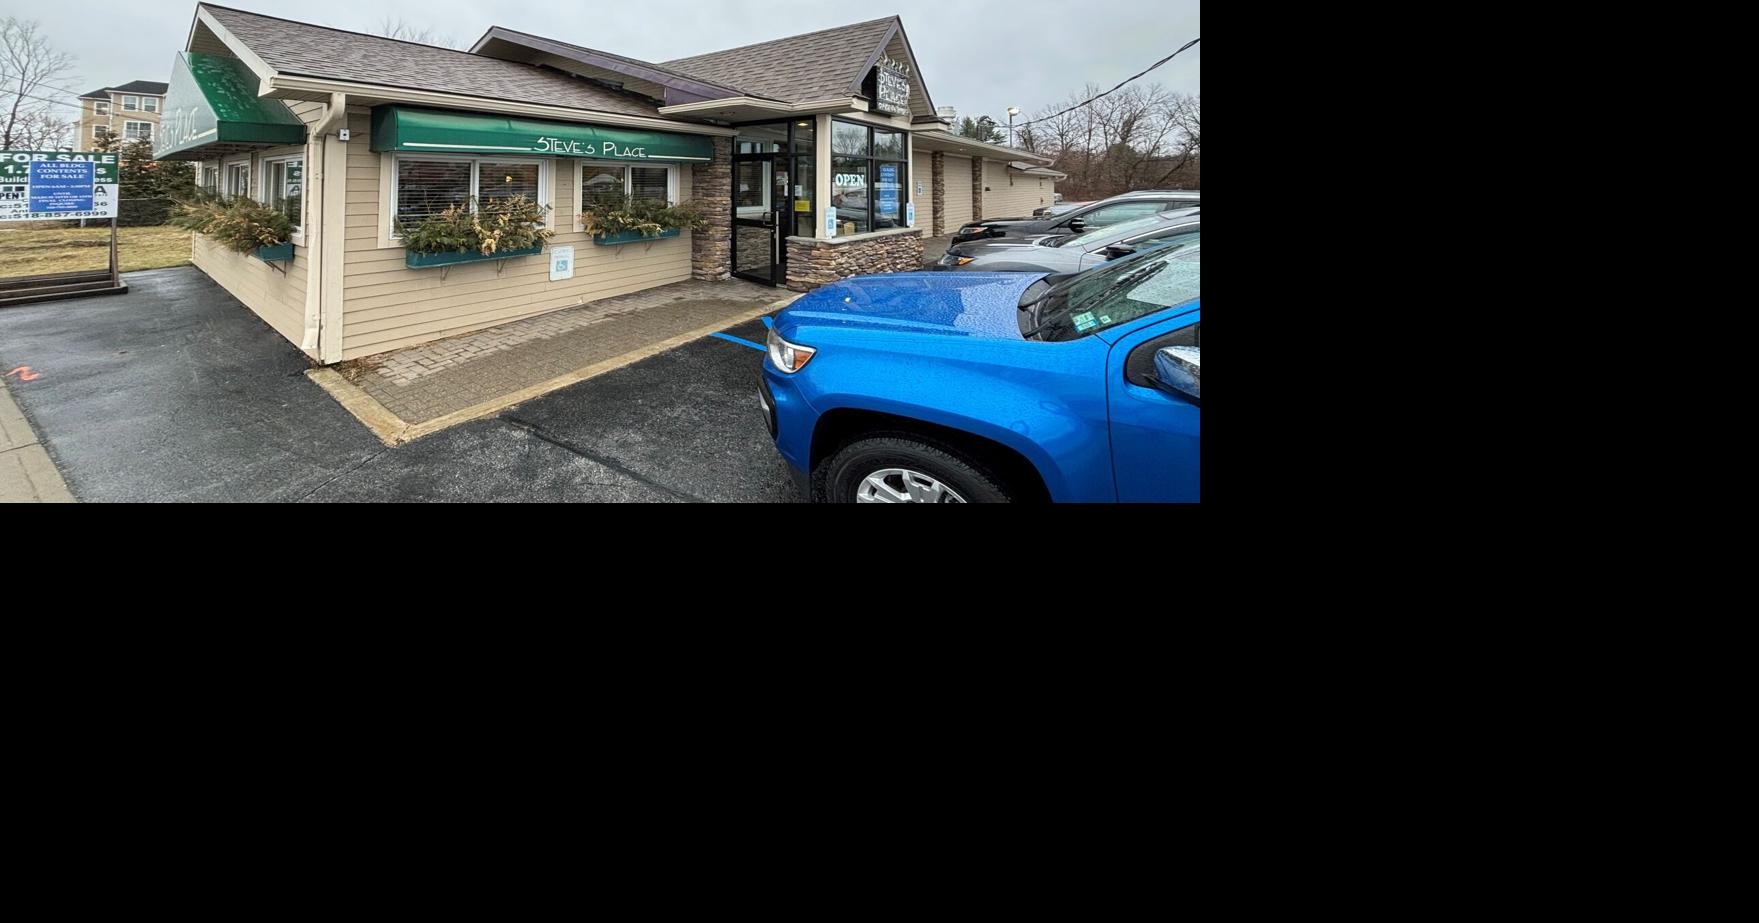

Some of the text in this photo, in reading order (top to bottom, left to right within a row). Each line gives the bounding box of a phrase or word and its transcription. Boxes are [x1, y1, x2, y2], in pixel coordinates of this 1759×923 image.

[534, 136, 647, 158] STEVE'S PLACE
[0, 153, 116, 164] FOR SALE
[835, 174, 865, 186] OPEN
